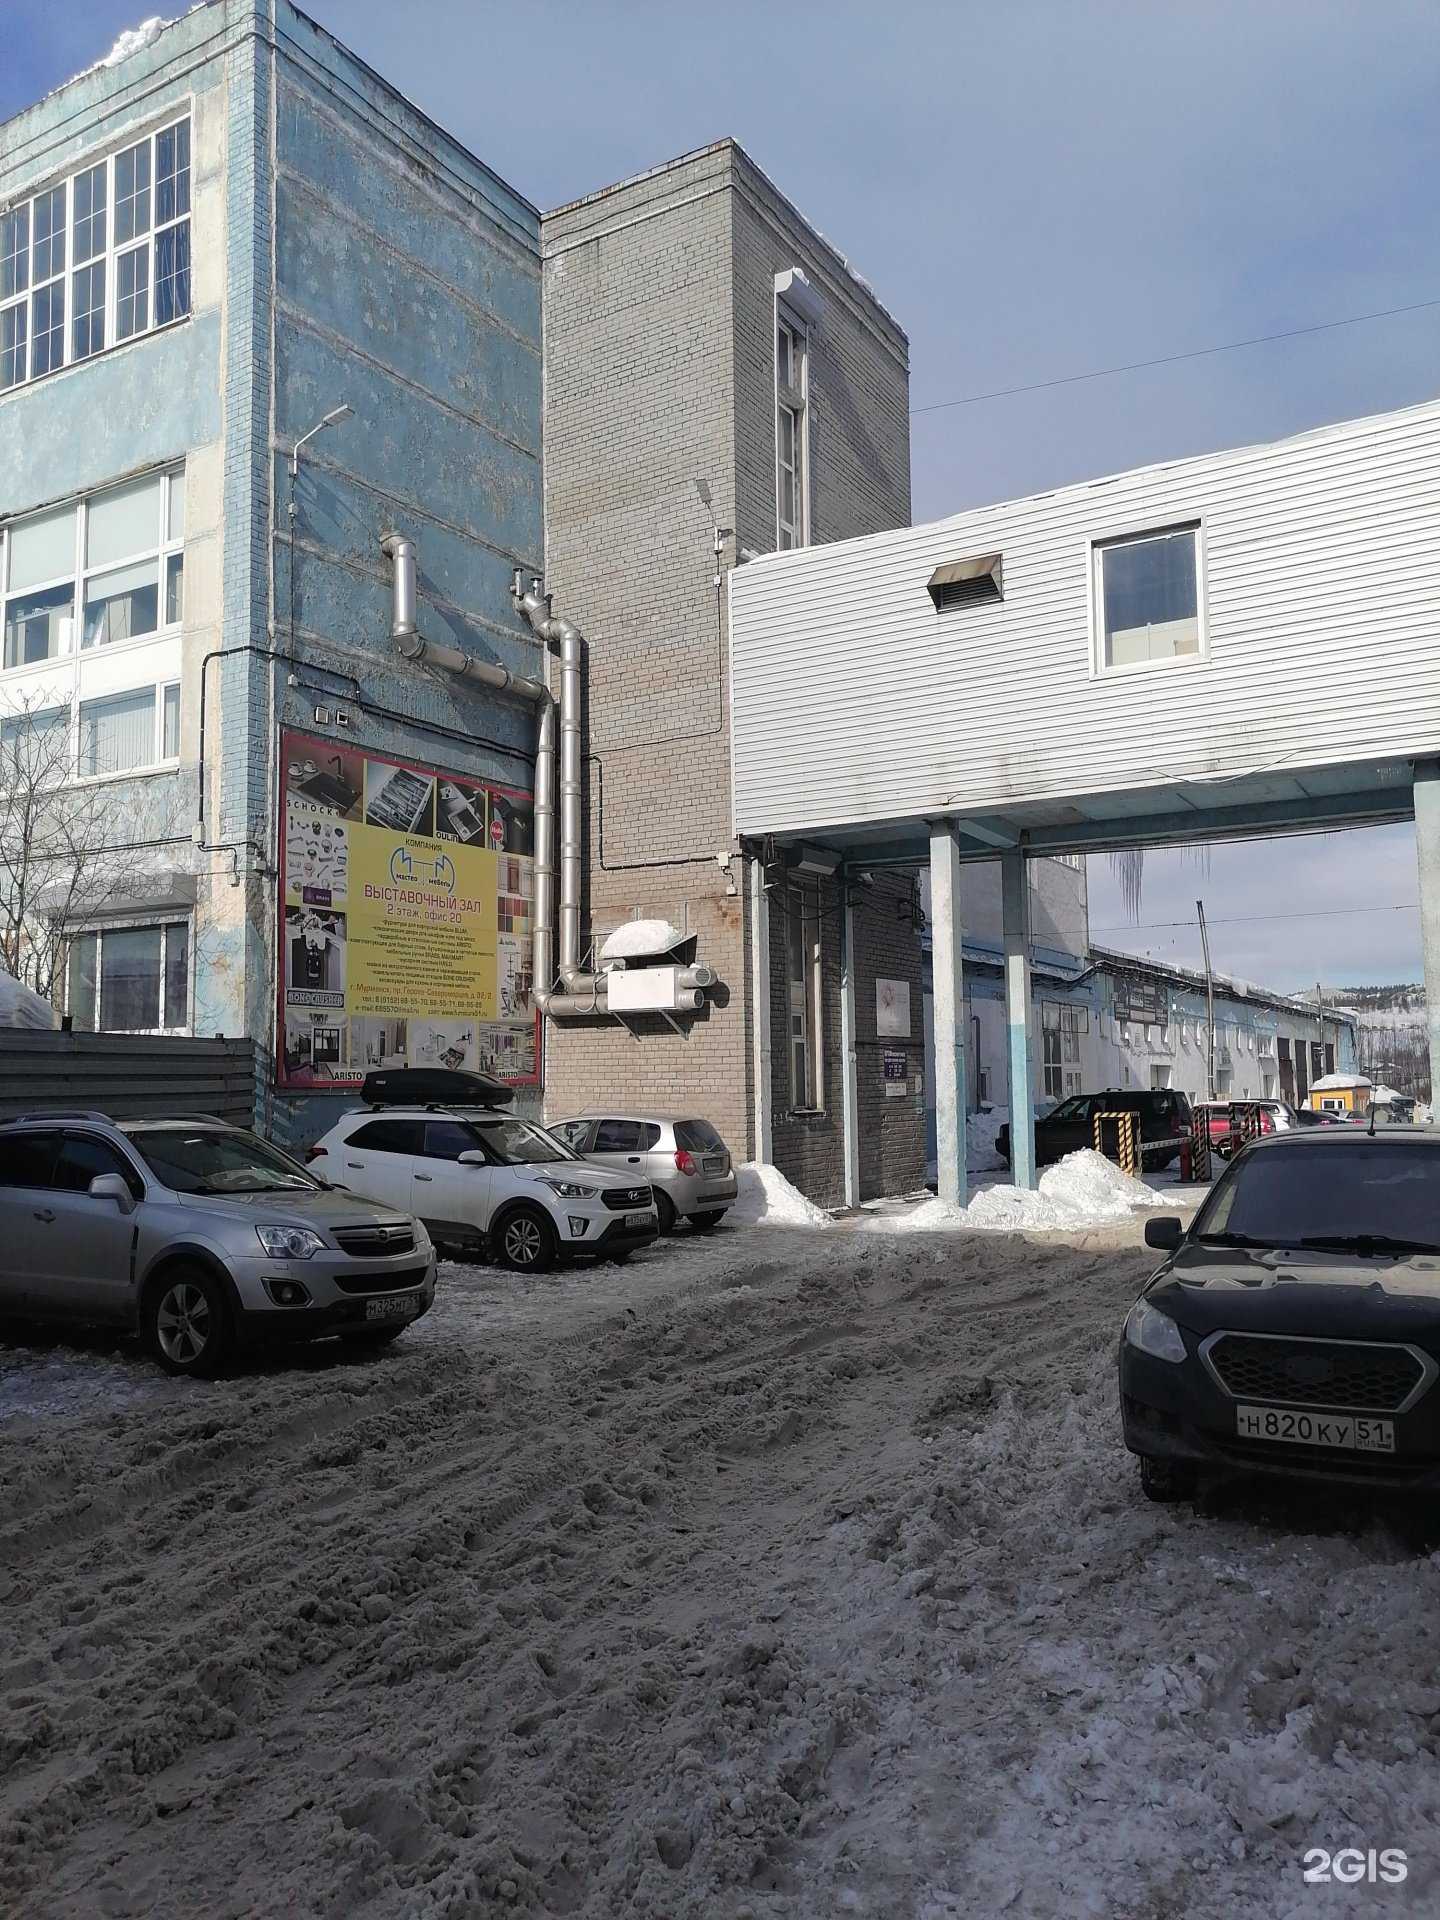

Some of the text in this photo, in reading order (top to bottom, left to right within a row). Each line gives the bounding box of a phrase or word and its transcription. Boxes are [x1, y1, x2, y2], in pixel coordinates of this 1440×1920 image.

[286, 799, 333, 816] SCHOCK
[405, 838, 443, 852] КОМПАНИЯ
[364, 884, 481, 913] ВЫСТАВОЧНЫЙ ЗАЛ
[387, 903, 462, 924] 2 этаж, офис 20
[335, 1071, 363, 1081] ARISTO
[1357, 1421, 1384, 1443] 51
